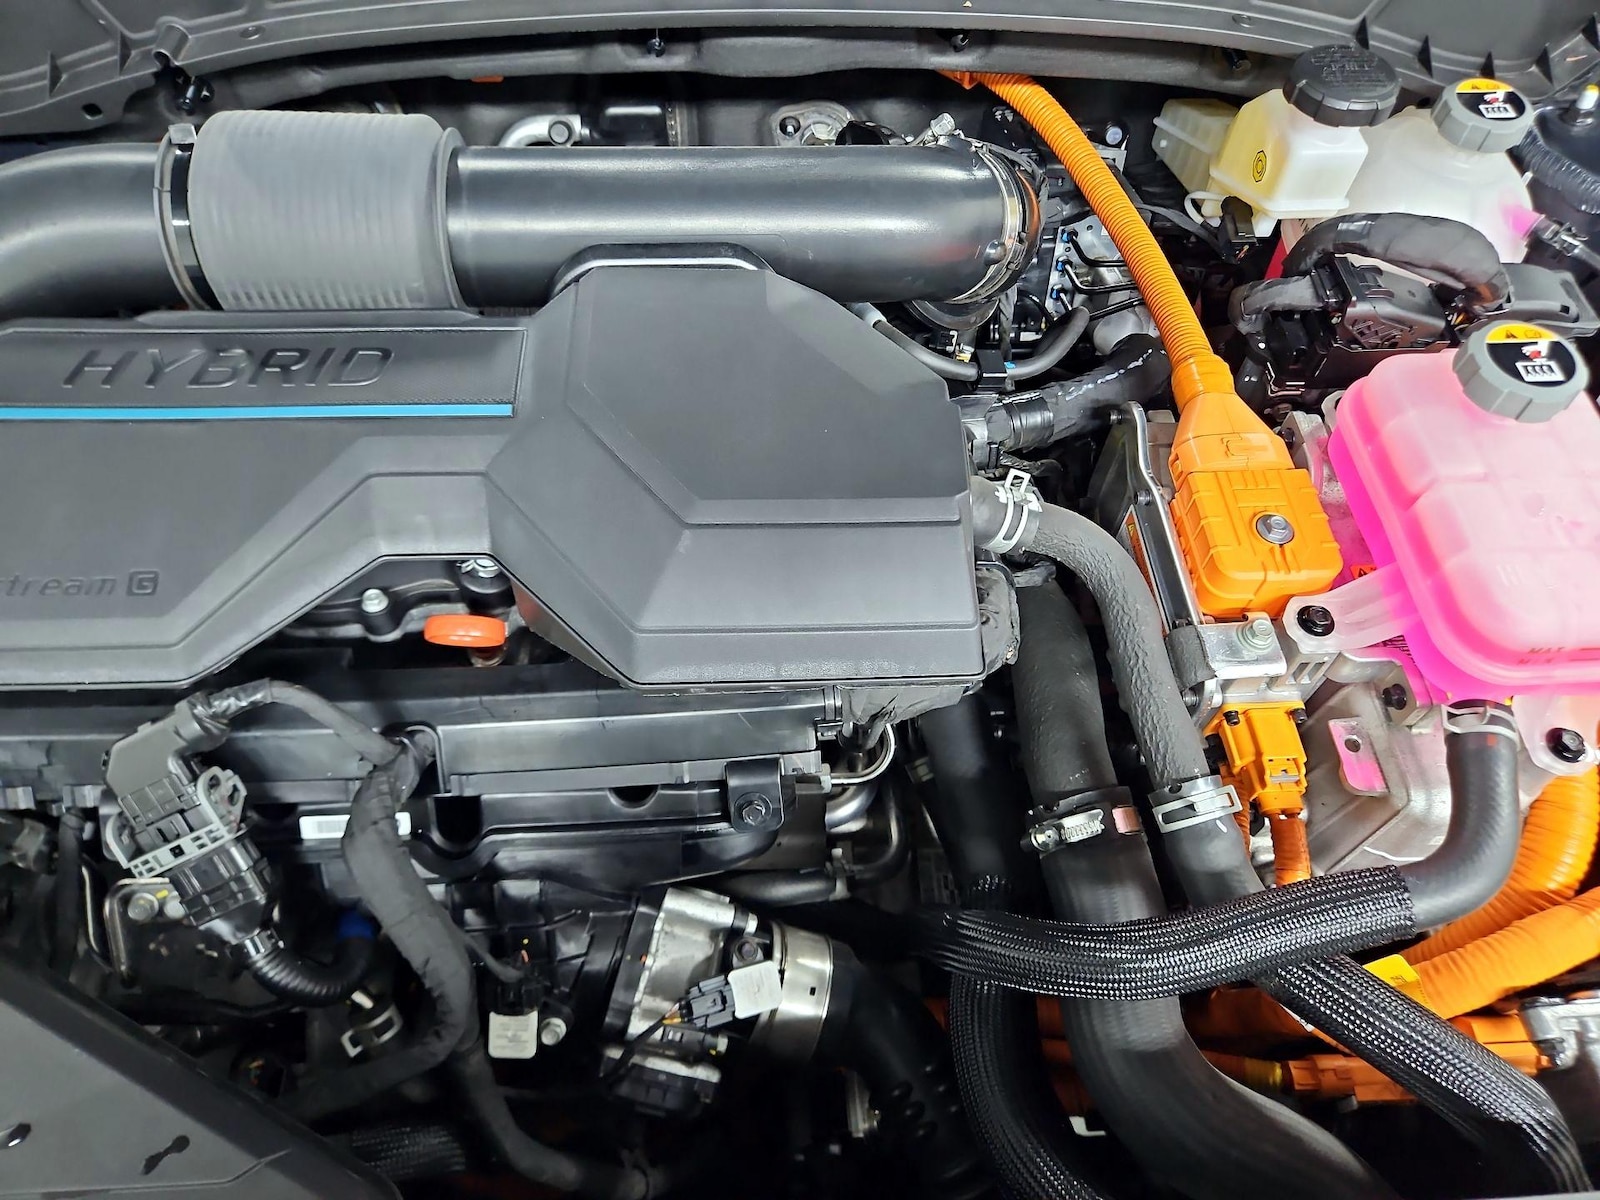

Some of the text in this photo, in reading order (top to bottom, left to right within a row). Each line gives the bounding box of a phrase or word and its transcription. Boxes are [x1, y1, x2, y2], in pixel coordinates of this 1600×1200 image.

[62, 347, 396, 388] HYBRID
[0, 570, 159, 597] tream G
